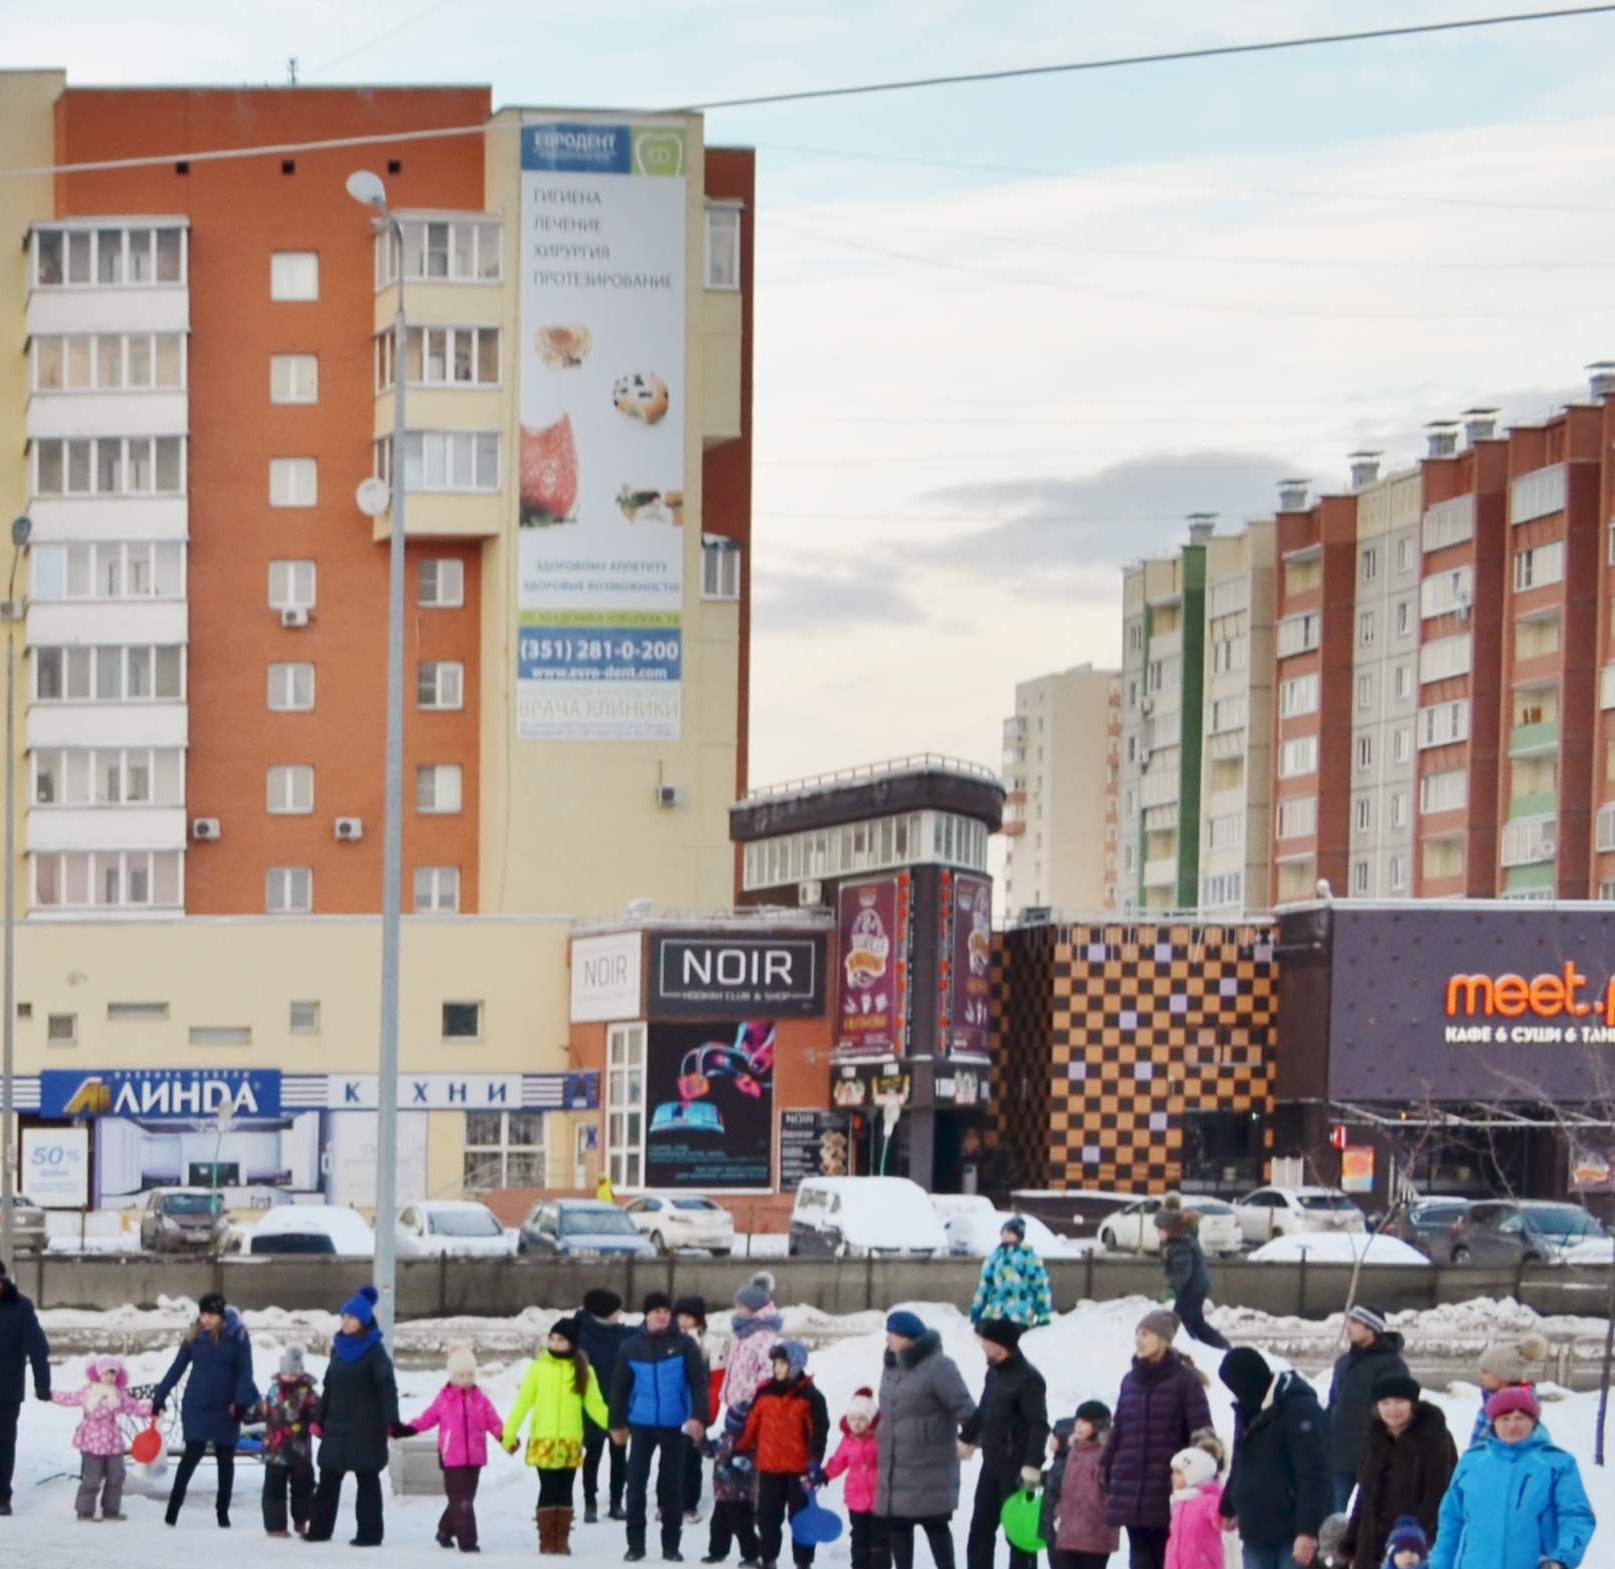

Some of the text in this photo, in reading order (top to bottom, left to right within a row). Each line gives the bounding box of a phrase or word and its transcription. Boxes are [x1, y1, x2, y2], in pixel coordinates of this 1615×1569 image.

[534, 189, 601, 206] ГИГИЕНА
[534, 216, 600, 233] ЛЕЧЕНИЕ
[534, 243, 610, 260] ХИРУРГИЯ
[534, 271, 673, 290] ПРОТЕЗИРОВАНИЕ
[537, 560, 668, 573] ЗДОРОВОМУ АППЕТИТУ
[524, 580, 583, 592] ЗДОРОВЫЕ
[521, 639, 679, 661] (351) 281-0-200
[532, 664, 668, 679] www.evro-dent.com
[520, 699, 678, 718] ВРАЧА КЛИНИКИ
[584, 954, 627, 987] NOIR
[682, 949, 793, 985] NOIR
[1445, 1025, 1491, 1042] КАФЕ
[1511, 1026, 1561, 1042] СУШИ
[345, 1082, 507, 1103] КХНИ
[32, 1146, 63, 1166] 50
